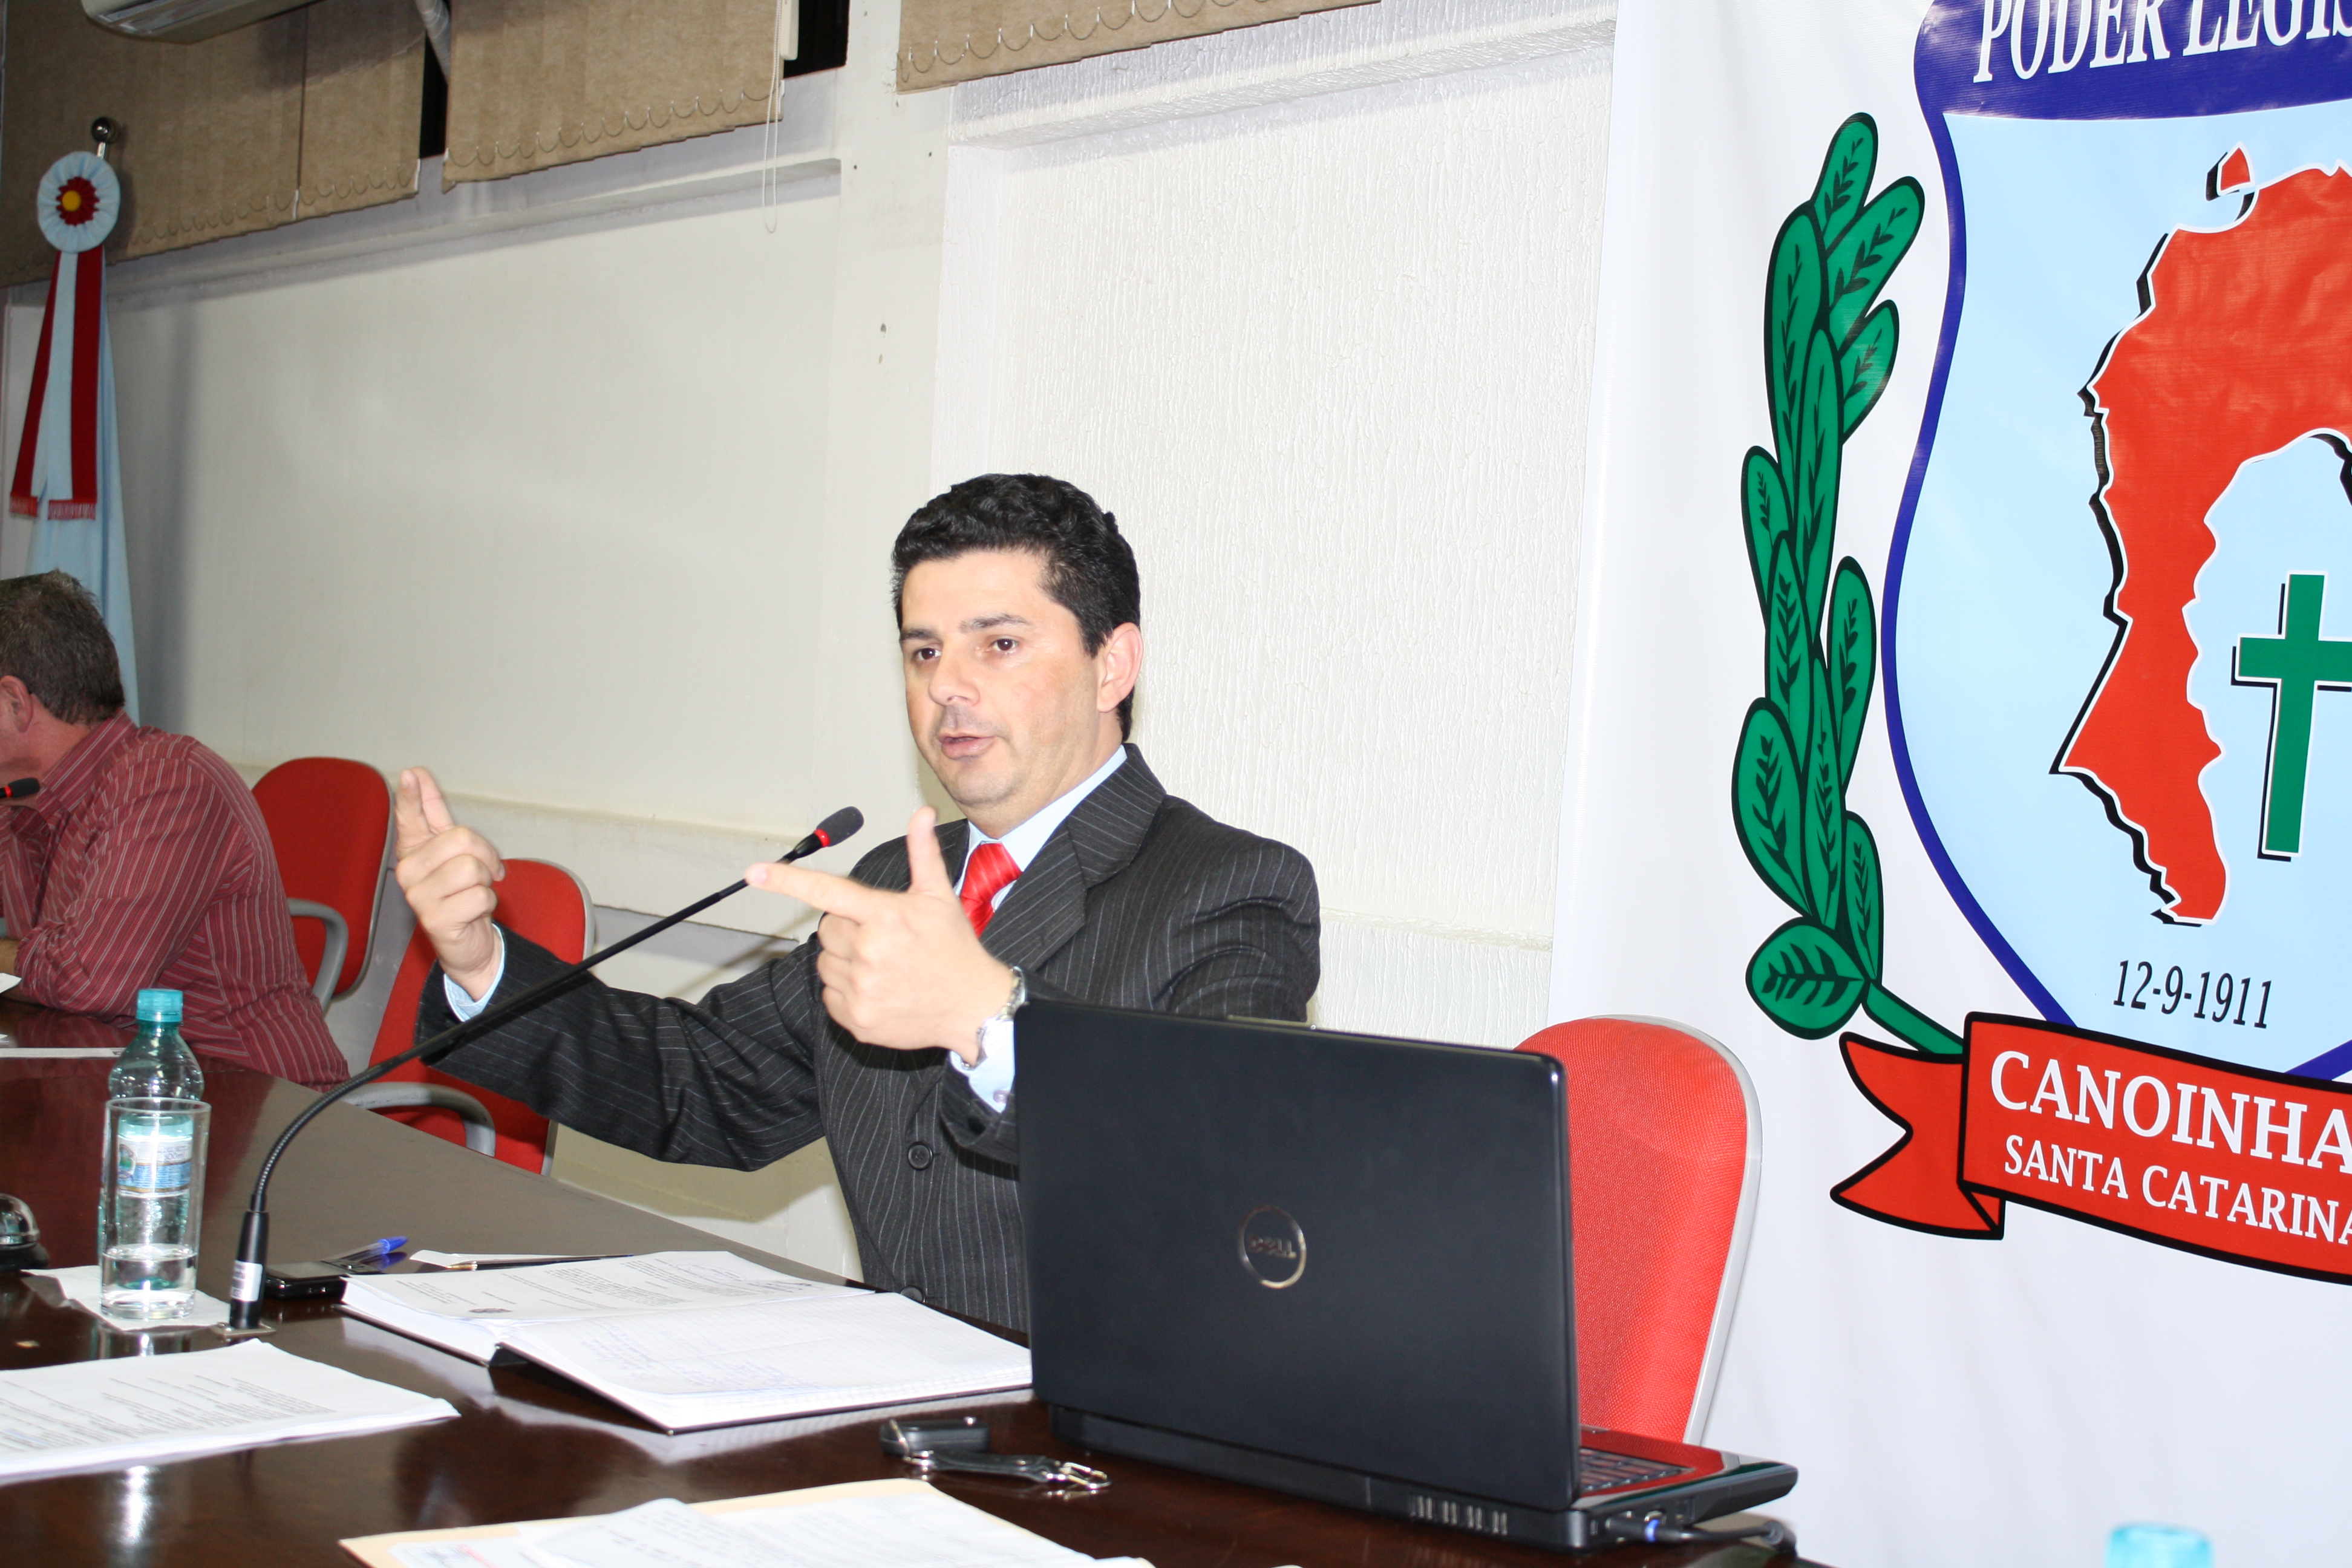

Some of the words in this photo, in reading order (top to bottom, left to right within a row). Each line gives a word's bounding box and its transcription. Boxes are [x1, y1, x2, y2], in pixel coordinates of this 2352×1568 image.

[1973, 0, 2171, 83] PODER
[2113, 959, 2272, 1029] 12-9-1911
[1991, 1051, 2352, 1174] CANOINHA
[2005, 1135, 2128, 1199] SANTA
[1248, 1235, 1297, 1259] DELL
